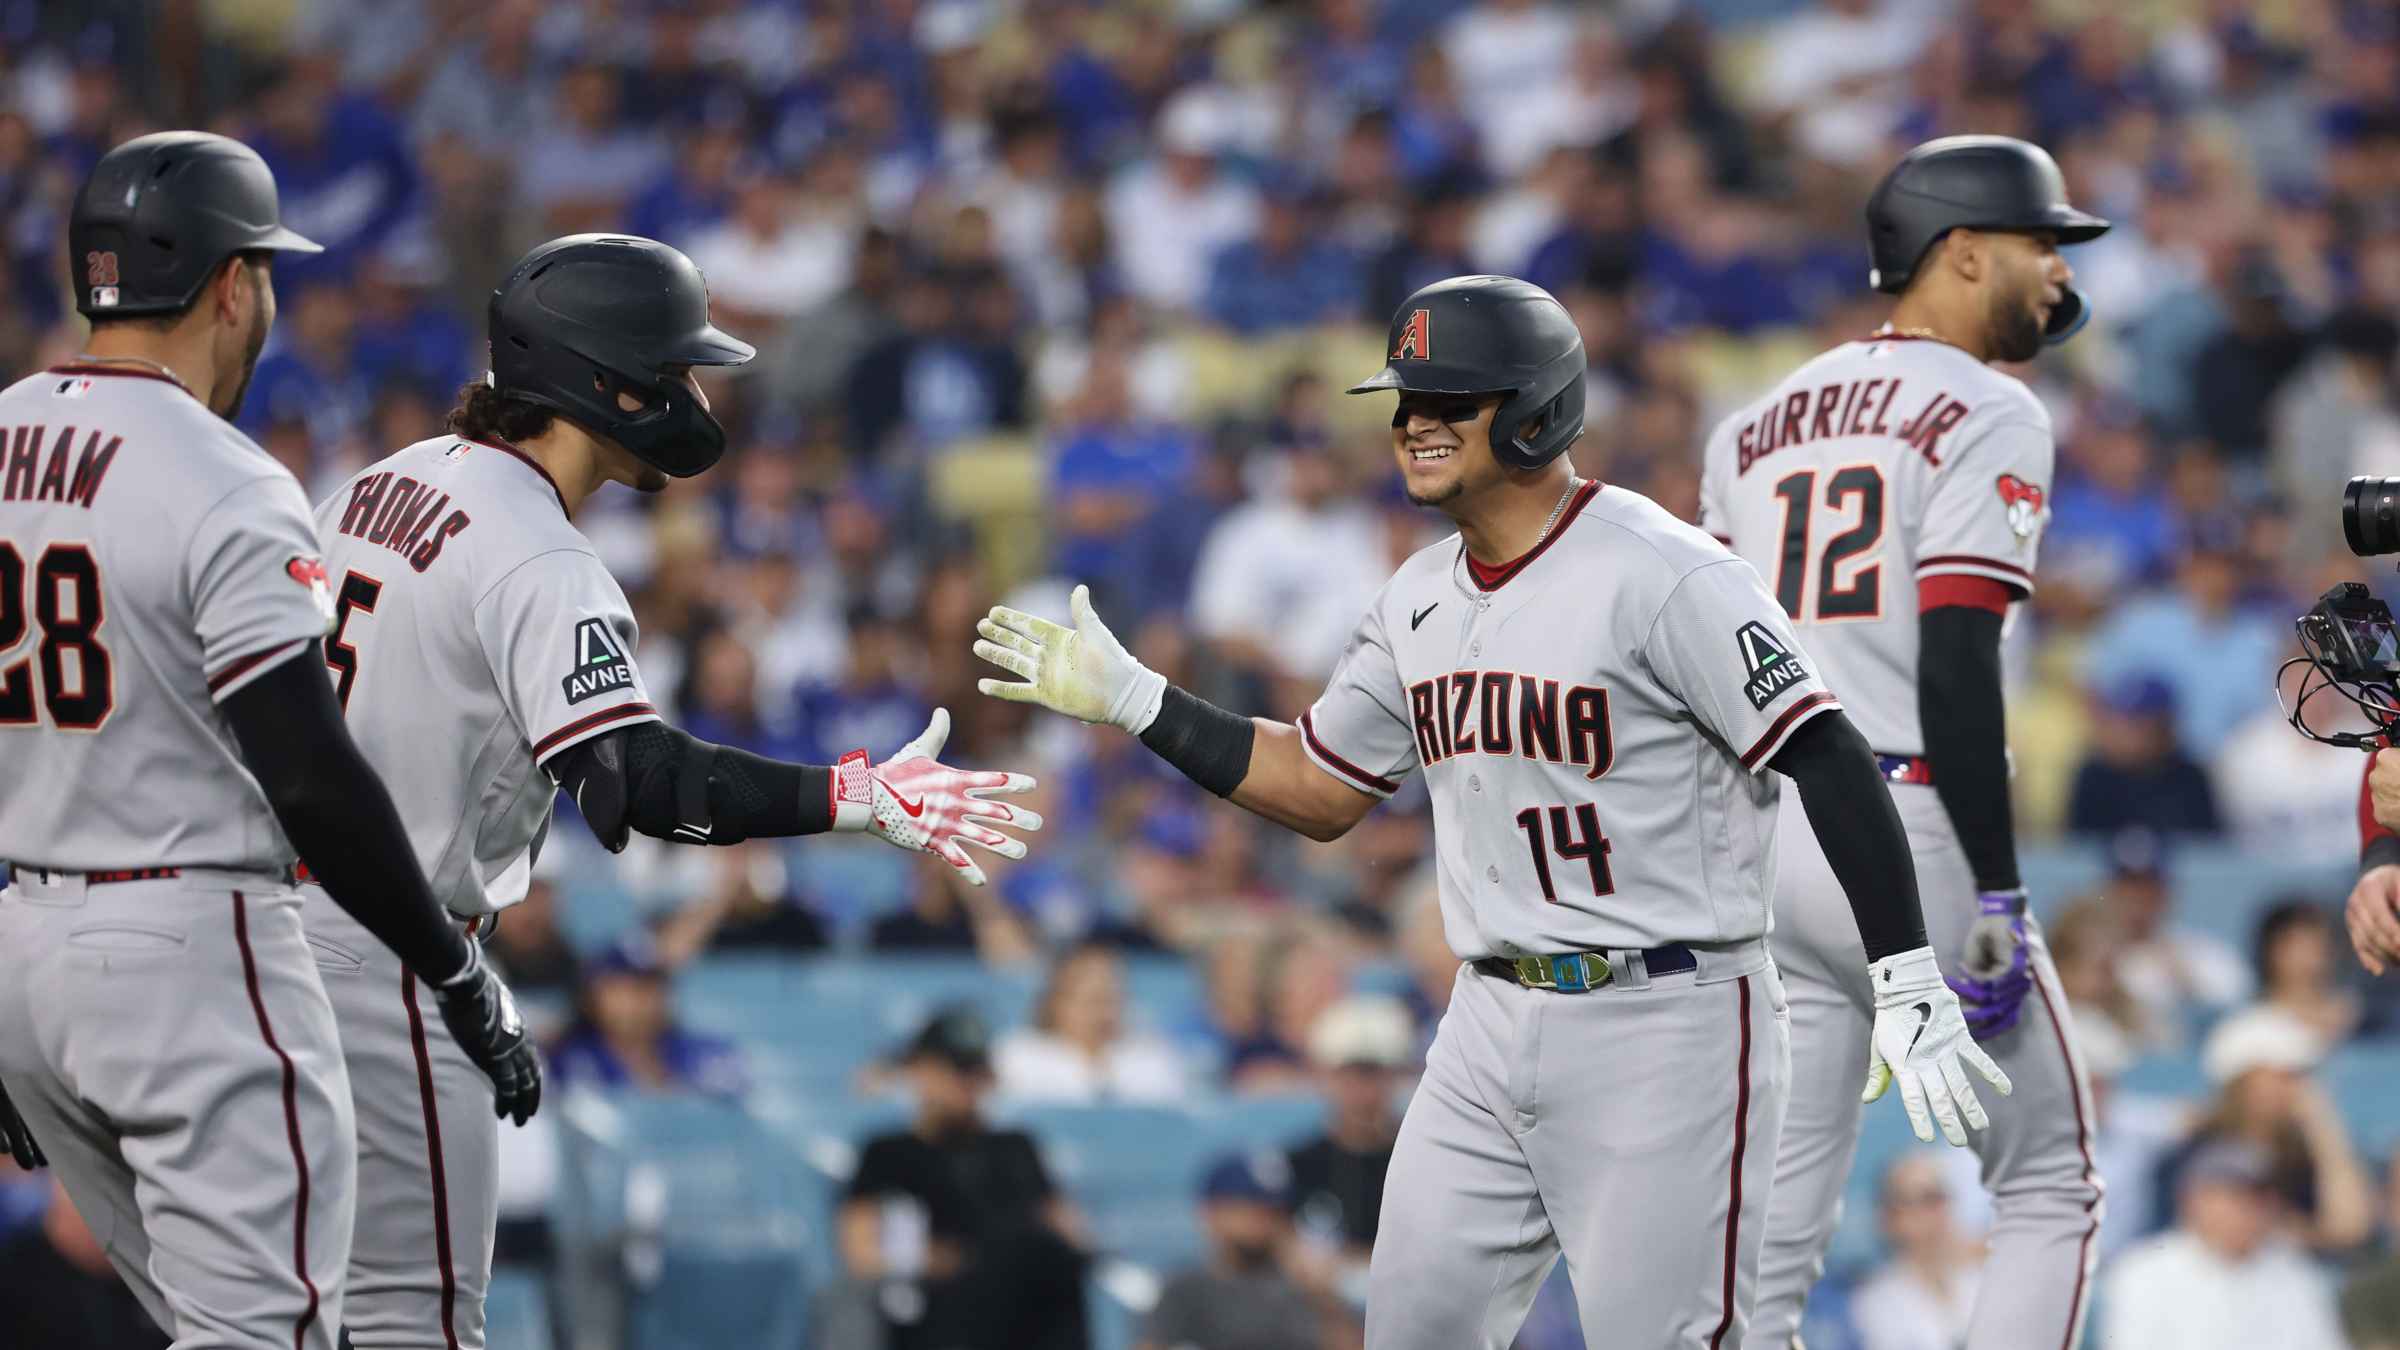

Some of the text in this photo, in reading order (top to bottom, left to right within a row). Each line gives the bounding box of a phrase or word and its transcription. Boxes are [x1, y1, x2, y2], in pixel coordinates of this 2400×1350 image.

[87, 251, 119, 285] 28
[0, 426, 123, 508] HAM
[1738, 378, 1902, 477] GURRIEL
[338, 471, 471, 573] THOMAS
[1774, 464, 1885, 623] 12
[571, 664, 632, 698] AVNE
[1403, 670, 1616, 783] RIZONA
[1751, 658, 1803, 704] AVNE
[1516, 802, 1615, 904] 14
